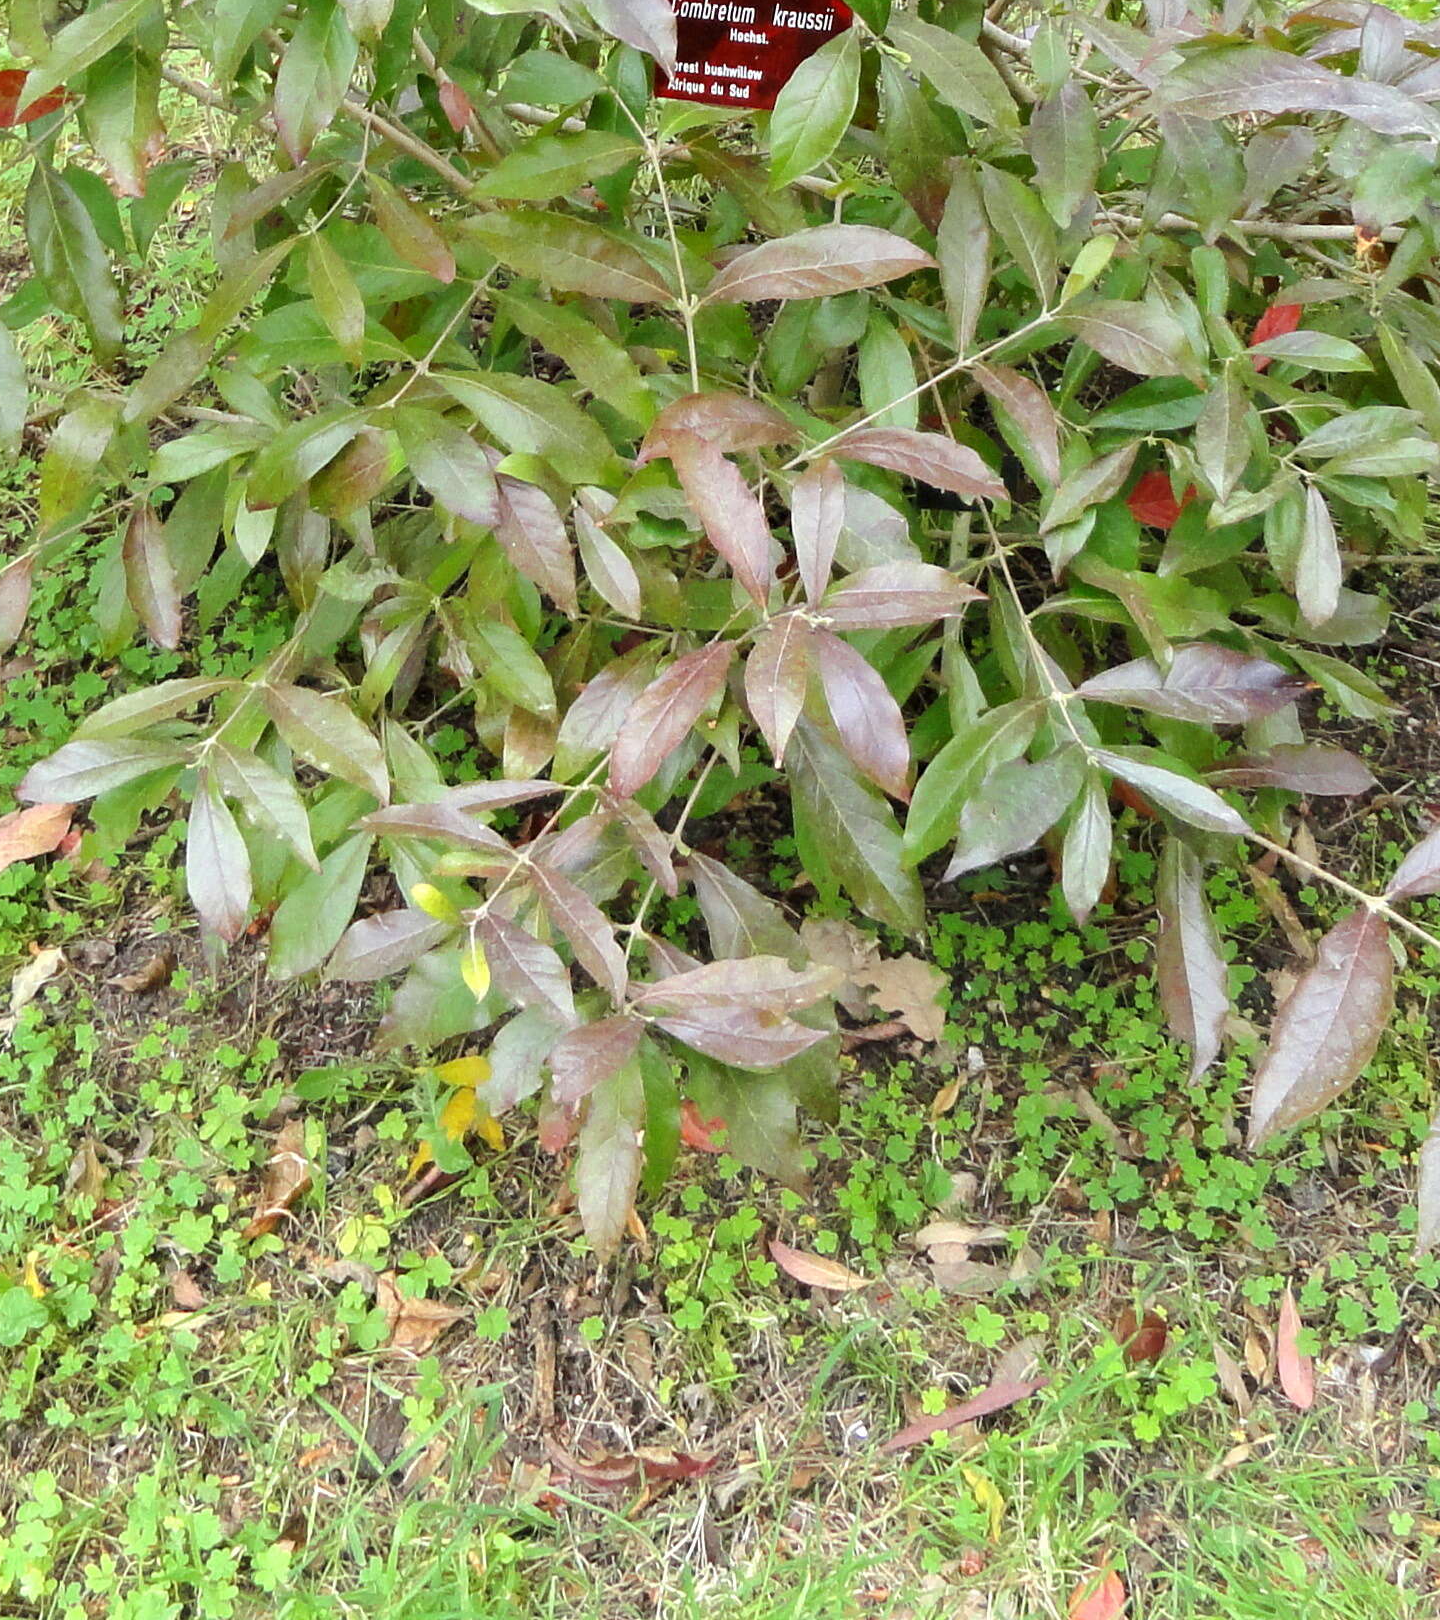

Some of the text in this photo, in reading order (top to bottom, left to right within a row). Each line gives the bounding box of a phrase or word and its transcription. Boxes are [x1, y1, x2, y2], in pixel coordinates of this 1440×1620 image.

[773, 3, 835, 31] kraussii
[729, 28, 769, 45] Hochst.
[704, 61, 763, 80] bushwillow
[667, 77, 750, 99] Afrique du Sud
